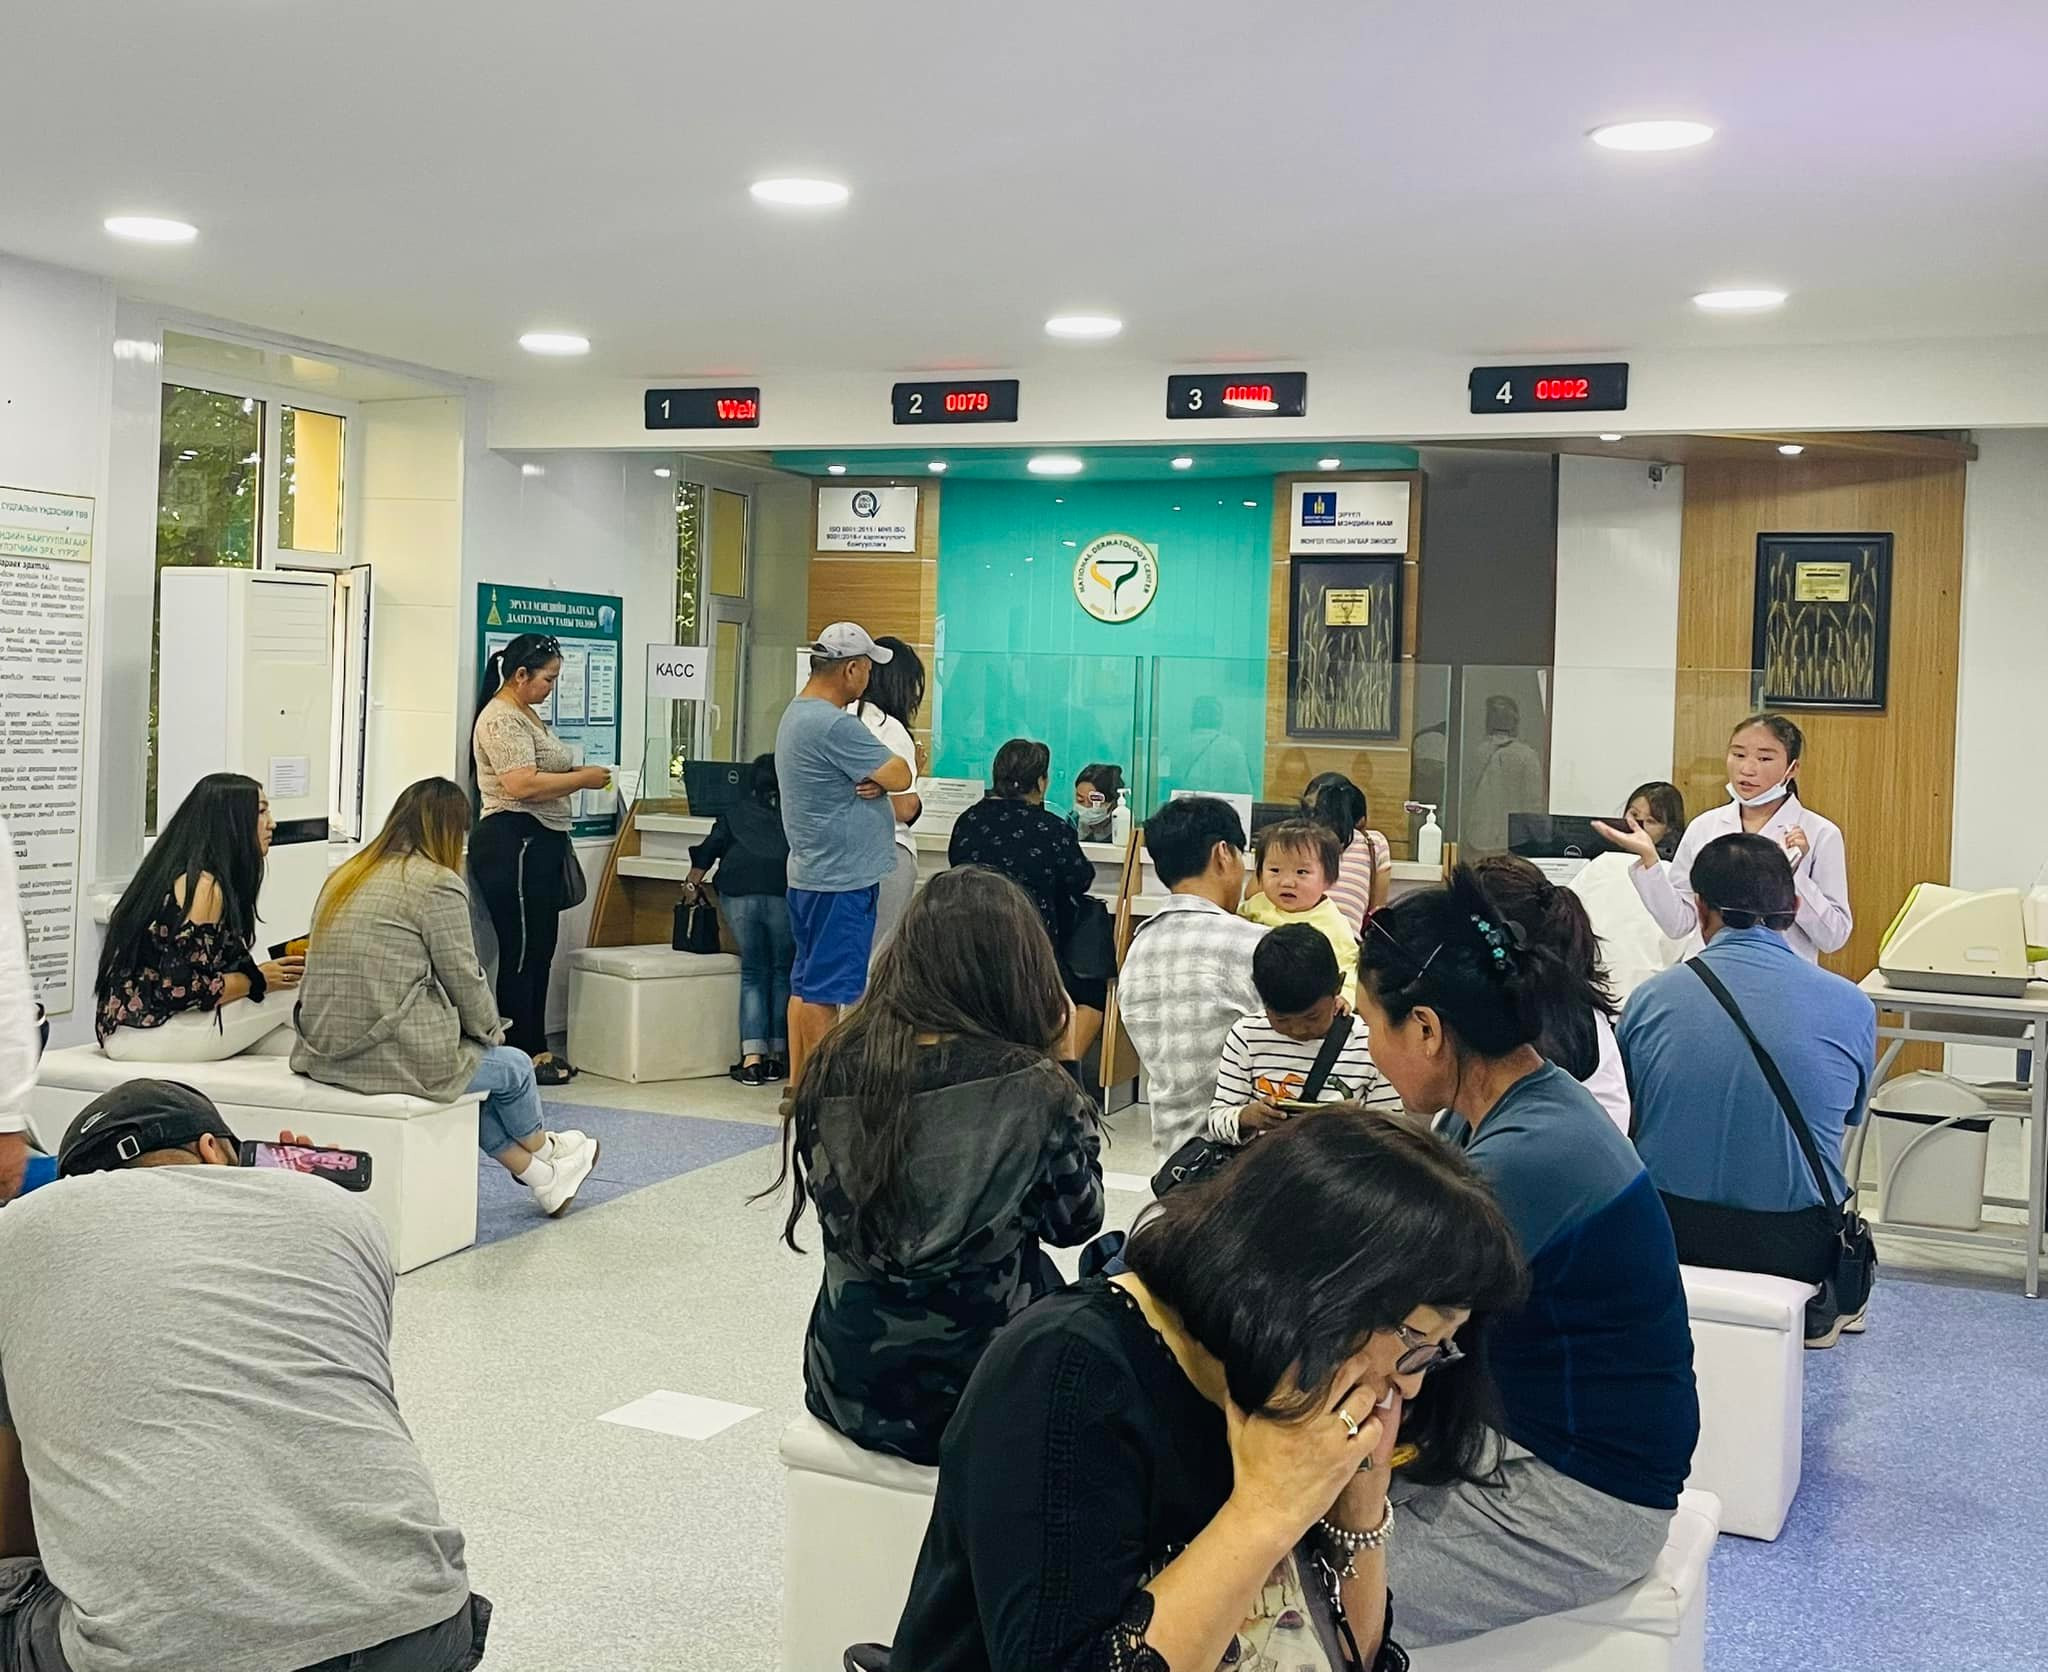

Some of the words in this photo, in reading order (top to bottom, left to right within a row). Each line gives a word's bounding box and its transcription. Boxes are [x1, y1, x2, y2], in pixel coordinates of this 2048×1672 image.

[945, 393, 989, 411] 0079
[1189, 388, 1203, 410] 3
[1495, 381, 1513, 404] 4
[661, 399, 671, 419] 1
[909, 393, 923, 414] 2
[1078, 553, 1094, 594] NATIONAL
[1091, 538, 1148, 562] DERMATOLOGY
[1143, 563, 1153, 594] CENTER
[656, 662, 695, 678] КАСС
